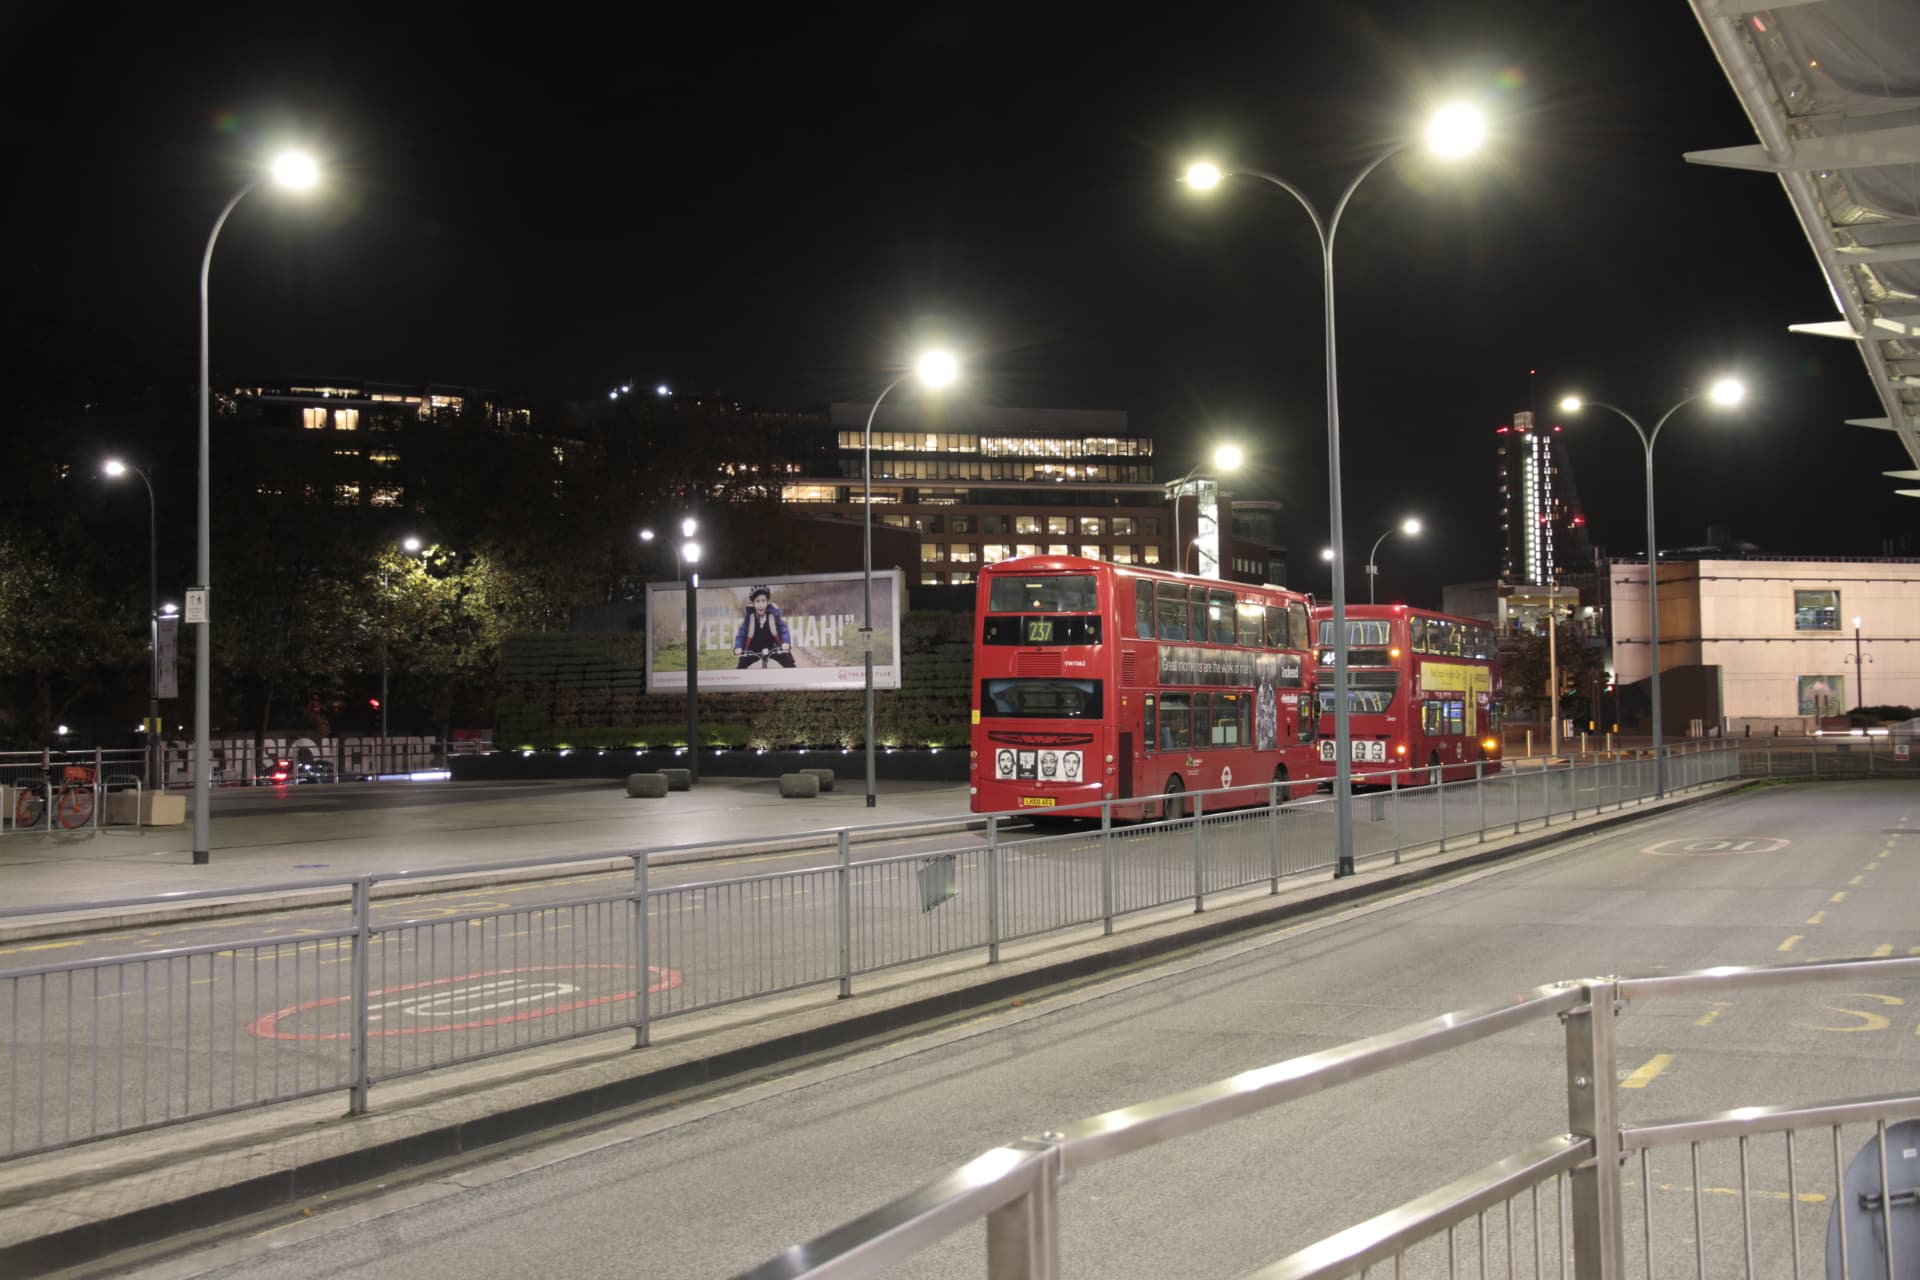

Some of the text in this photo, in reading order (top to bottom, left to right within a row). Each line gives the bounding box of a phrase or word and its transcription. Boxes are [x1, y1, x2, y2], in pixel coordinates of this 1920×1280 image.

[1029, 622, 1052, 641] 237
[1162, 657, 1178, 671] Great
[1203, 662, 1212, 673] are
[1212, 661, 1221, 673] the
[1234, 662, 1240, 674] of
